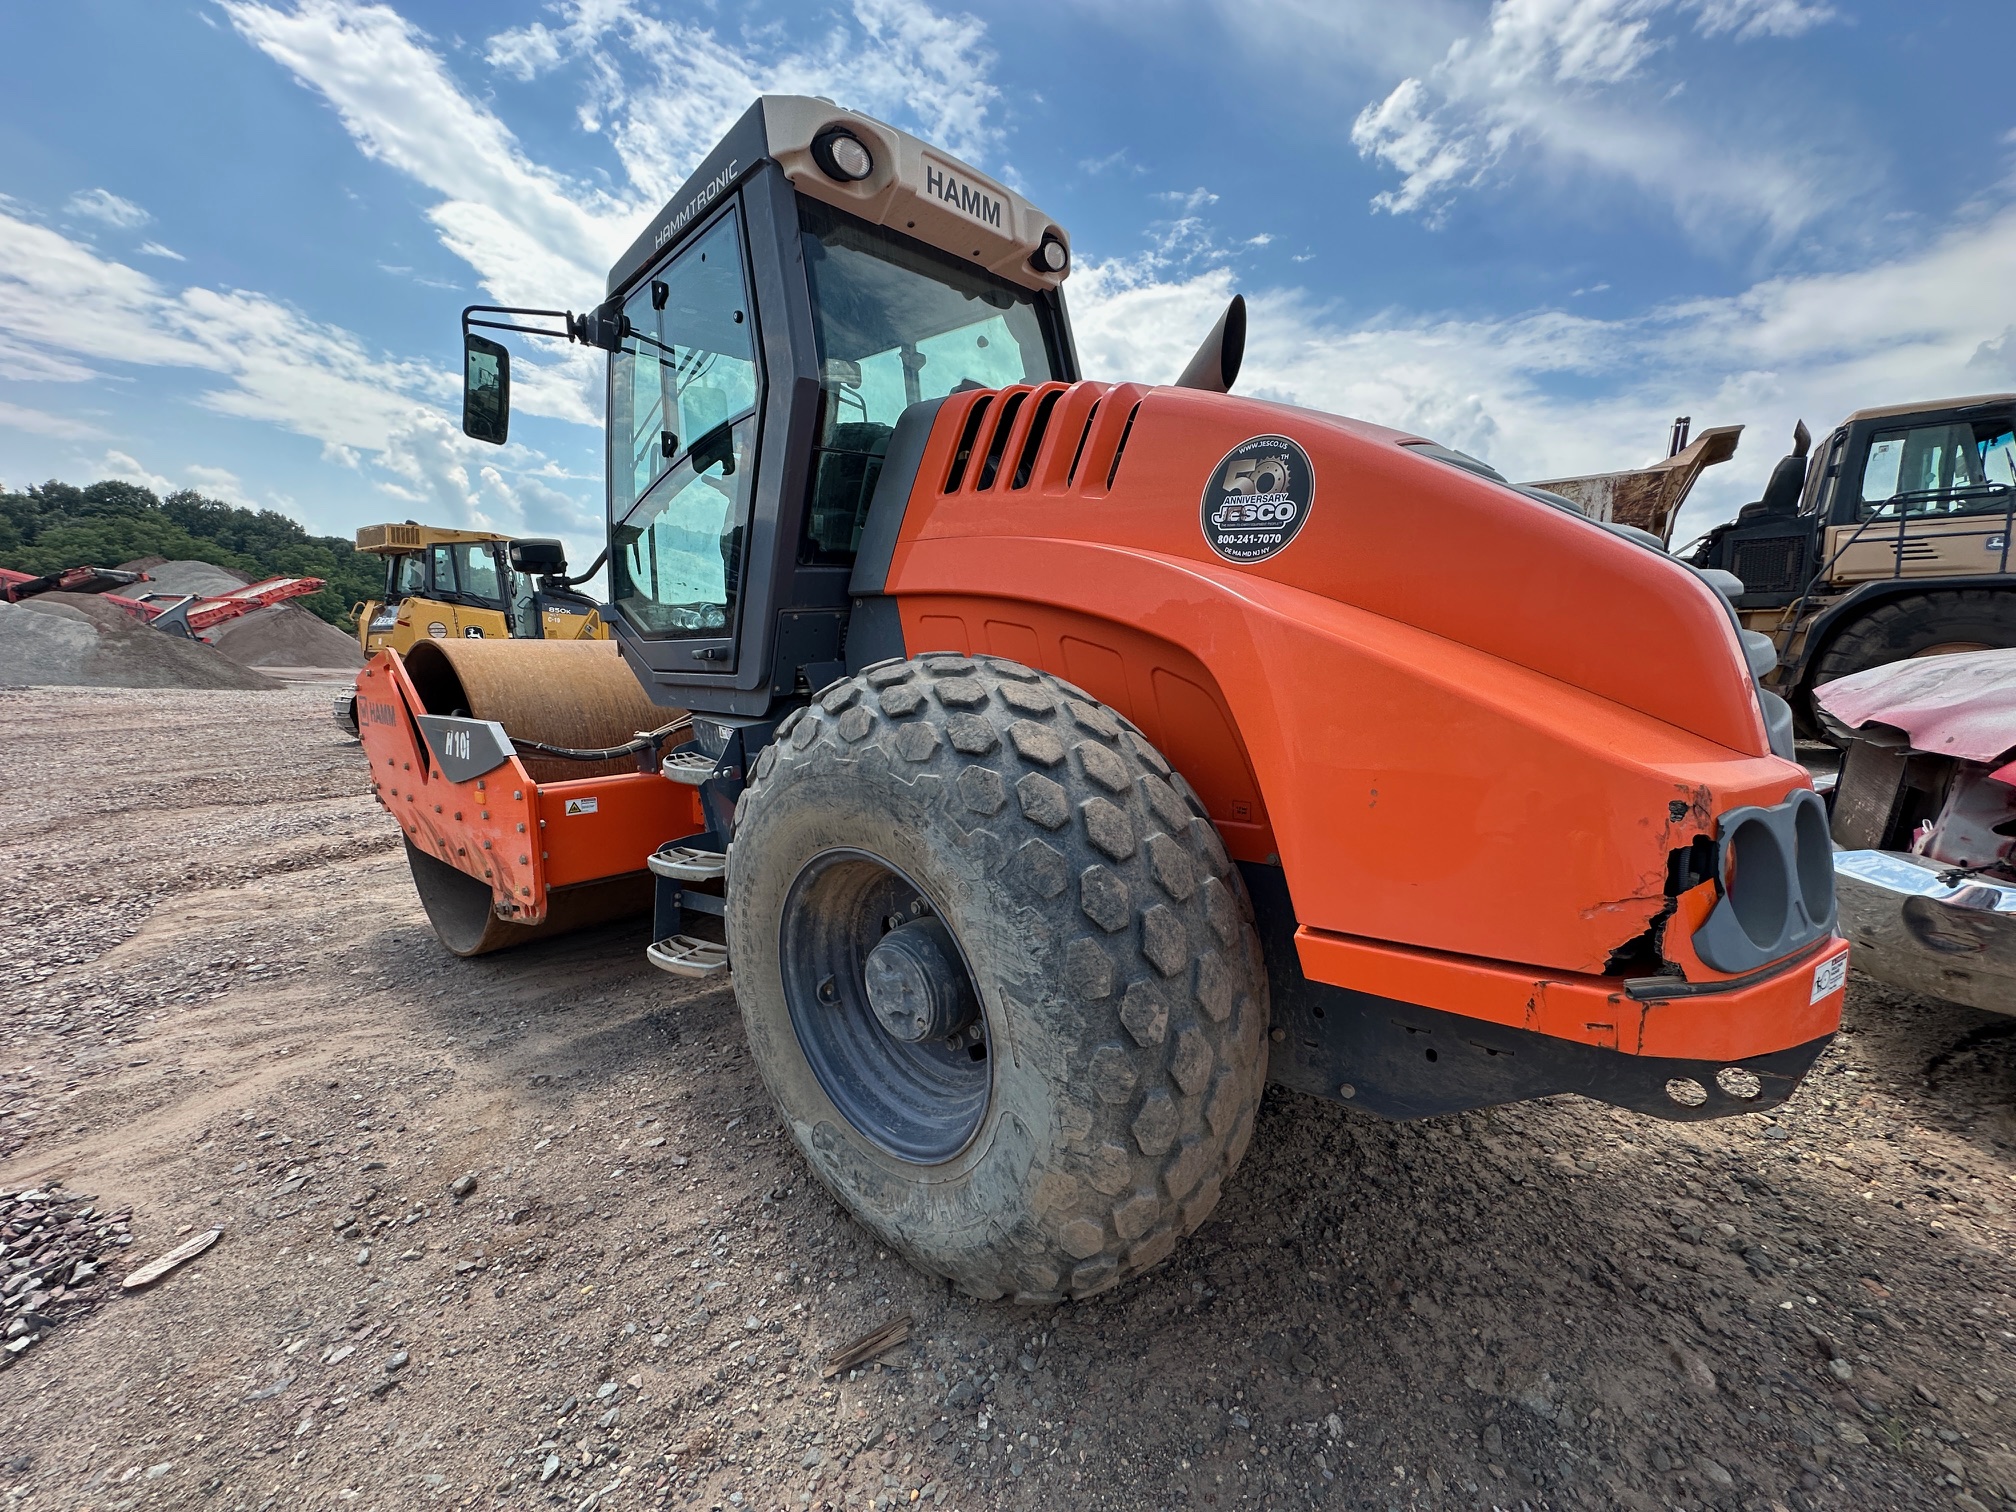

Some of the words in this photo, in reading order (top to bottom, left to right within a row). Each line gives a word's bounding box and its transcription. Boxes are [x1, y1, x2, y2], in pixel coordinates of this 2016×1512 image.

[654, 158, 738, 250] HAMMTRONIC
[927, 165, 1001, 229] HAMM
[1238, 440, 1289, 455] WWW.JESCO.US
[1224, 493, 1288, 506] ANNIVERSARY
[1213, 503, 1295, 522] JESCO
[1217, 533, 1282, 544] 800-241-7070
[1224, 546, 1232, 554] DE
[1252, 549, 1261, 557] NJ
[368, 701, 397, 728] HAMM
[445, 729, 454, 756] H
